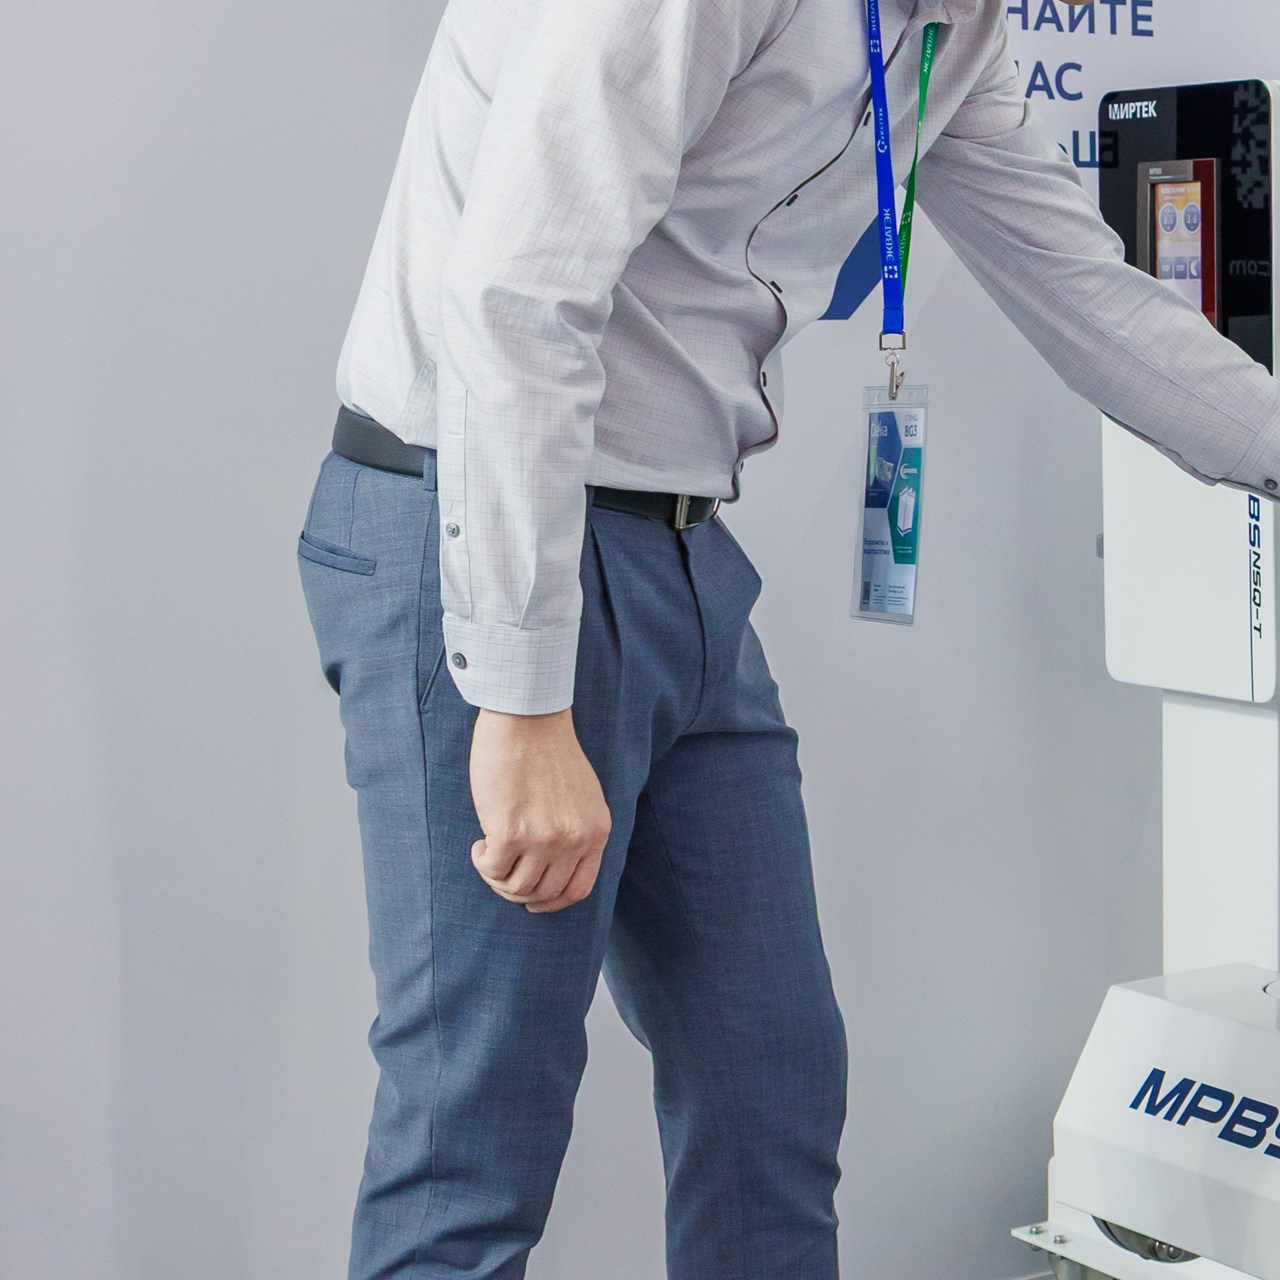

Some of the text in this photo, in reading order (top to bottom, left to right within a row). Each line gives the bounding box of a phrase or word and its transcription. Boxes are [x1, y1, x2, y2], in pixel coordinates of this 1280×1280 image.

[1014, 60, 1083, 101] АС
[1108, 101, 1157, 120] МИРТЕК
[1248, 494, 1261, 549] BS
